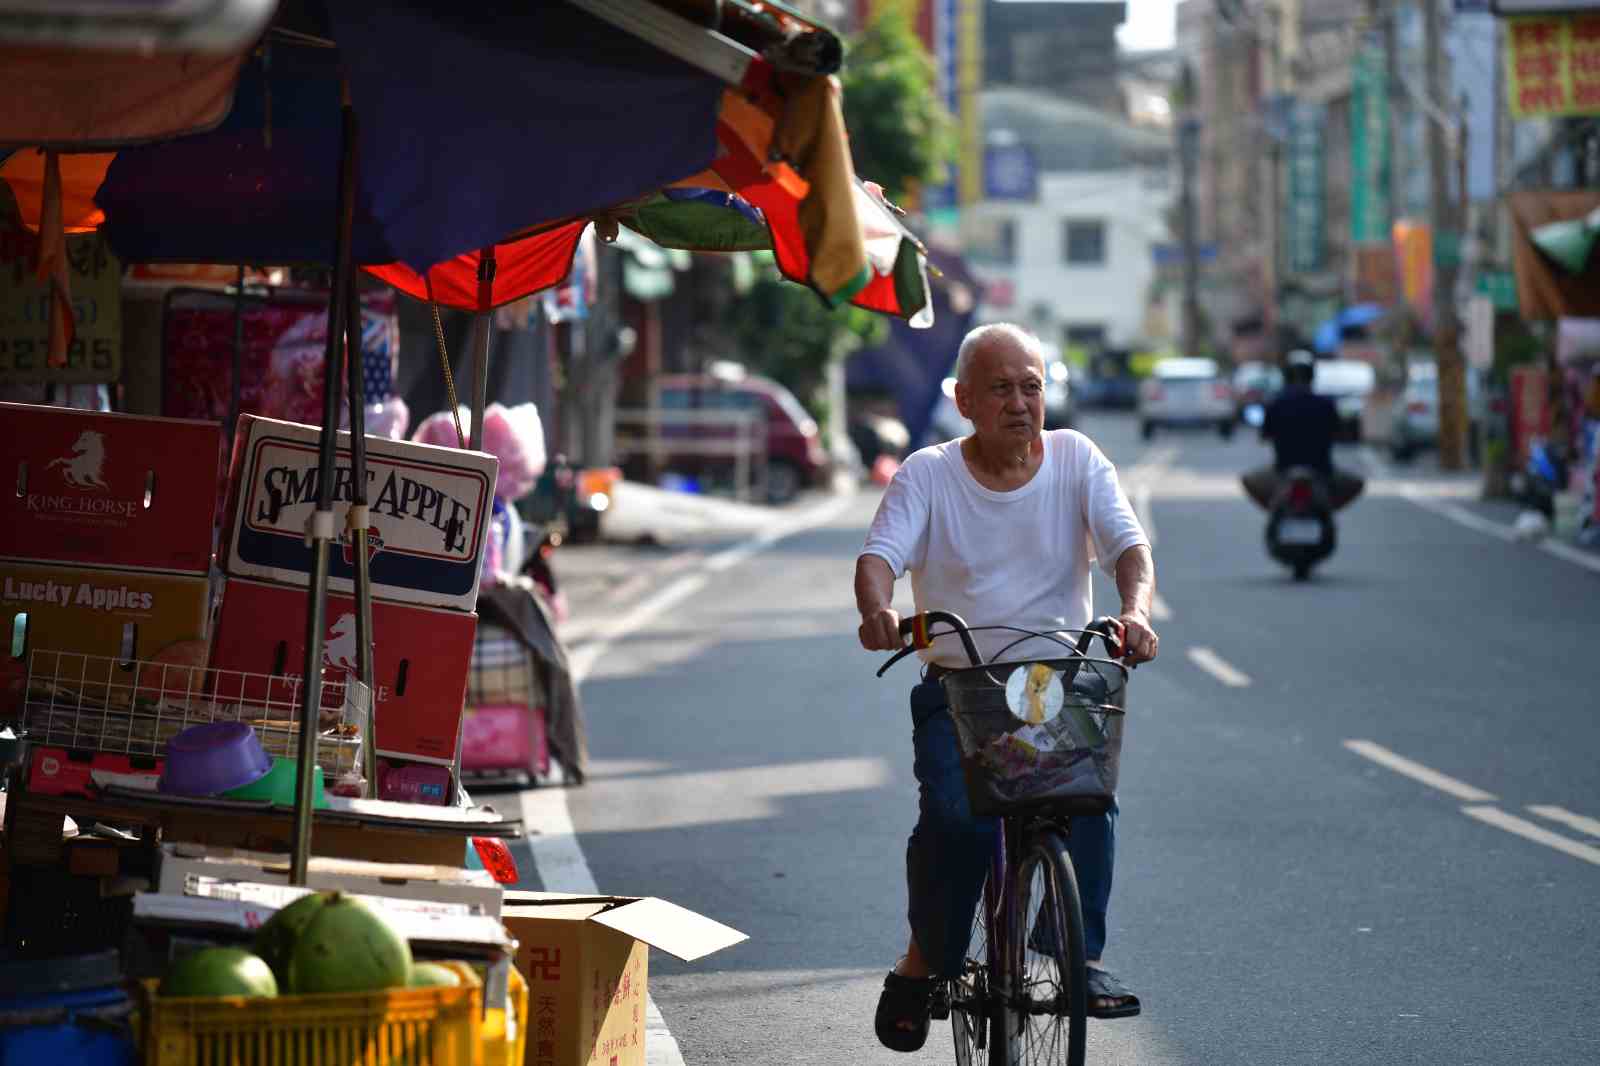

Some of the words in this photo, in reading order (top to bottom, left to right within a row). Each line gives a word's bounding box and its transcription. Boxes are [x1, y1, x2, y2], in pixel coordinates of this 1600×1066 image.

[26, 494, 73, 513] KING
[79, 496, 137, 518] HORSE
[257, 466, 375, 524] SMR
[370, 469, 471, 554] APPLE
[2, 576, 73, 608] Lucky
[75, 583, 153, 611] Apples
